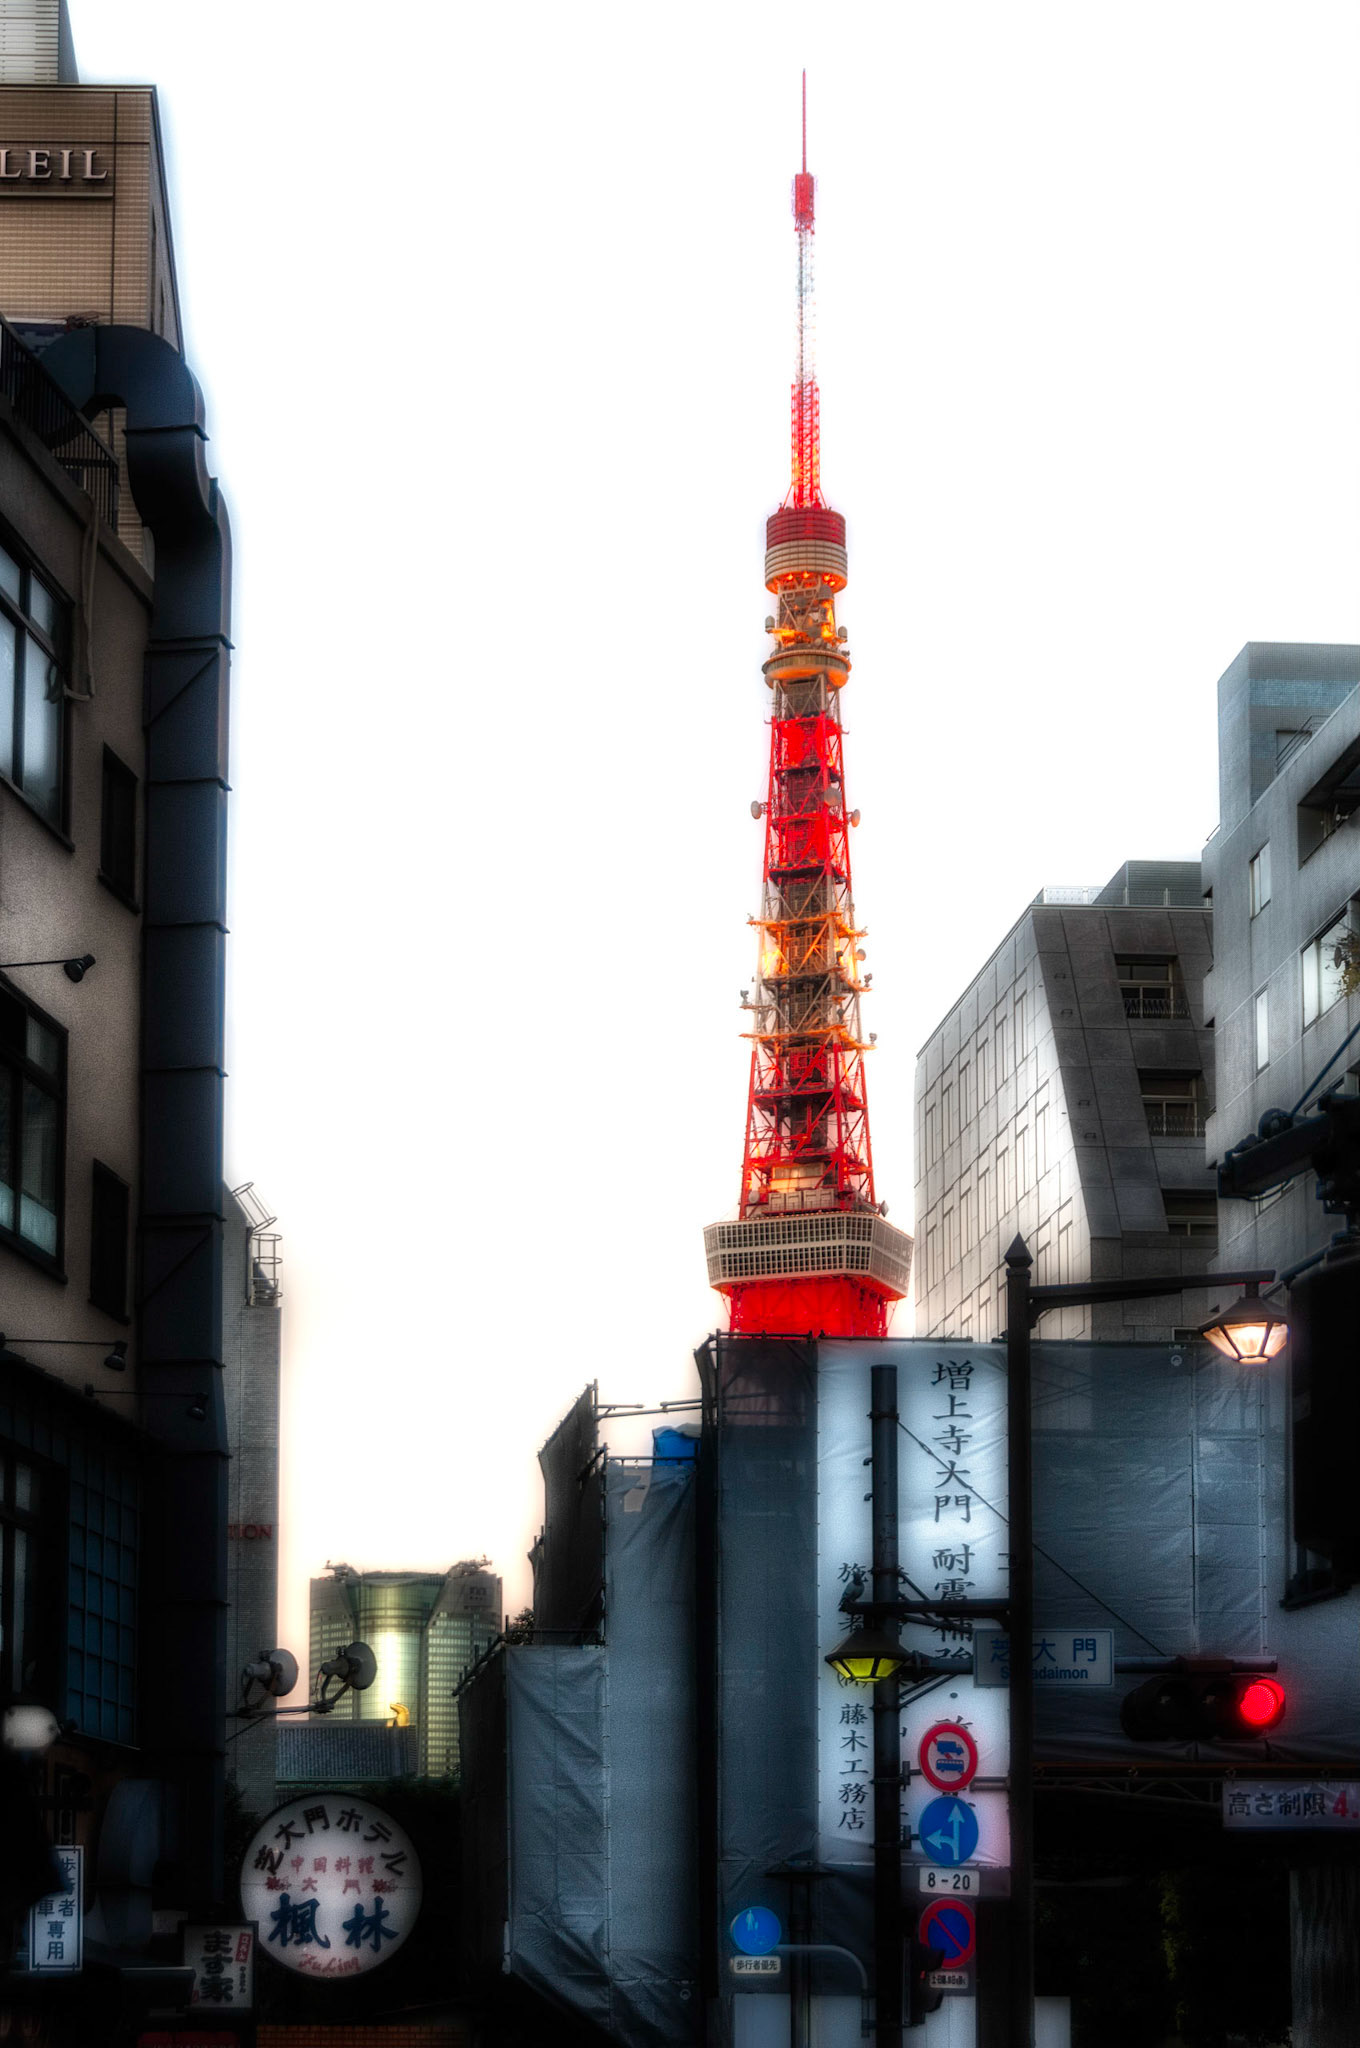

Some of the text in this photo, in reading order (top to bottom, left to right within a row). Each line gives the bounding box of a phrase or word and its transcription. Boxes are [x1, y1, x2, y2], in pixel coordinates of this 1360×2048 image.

[0, 149, 109, 181] LEIL
[932, 1359, 976, 1523] 増上寺大門
[1000, 1666, 1089, 1680] Sadaimon
[838, 1703, 869, 1830] 藤木工務店
[1228, 1791, 1326, 1816] 高さ制限
[255, 1805, 407, 1875] 芝大門ホテル
[268, 1892, 399, 1952] 楓林
[736, 1959, 778, 1970] 歩行者優先
